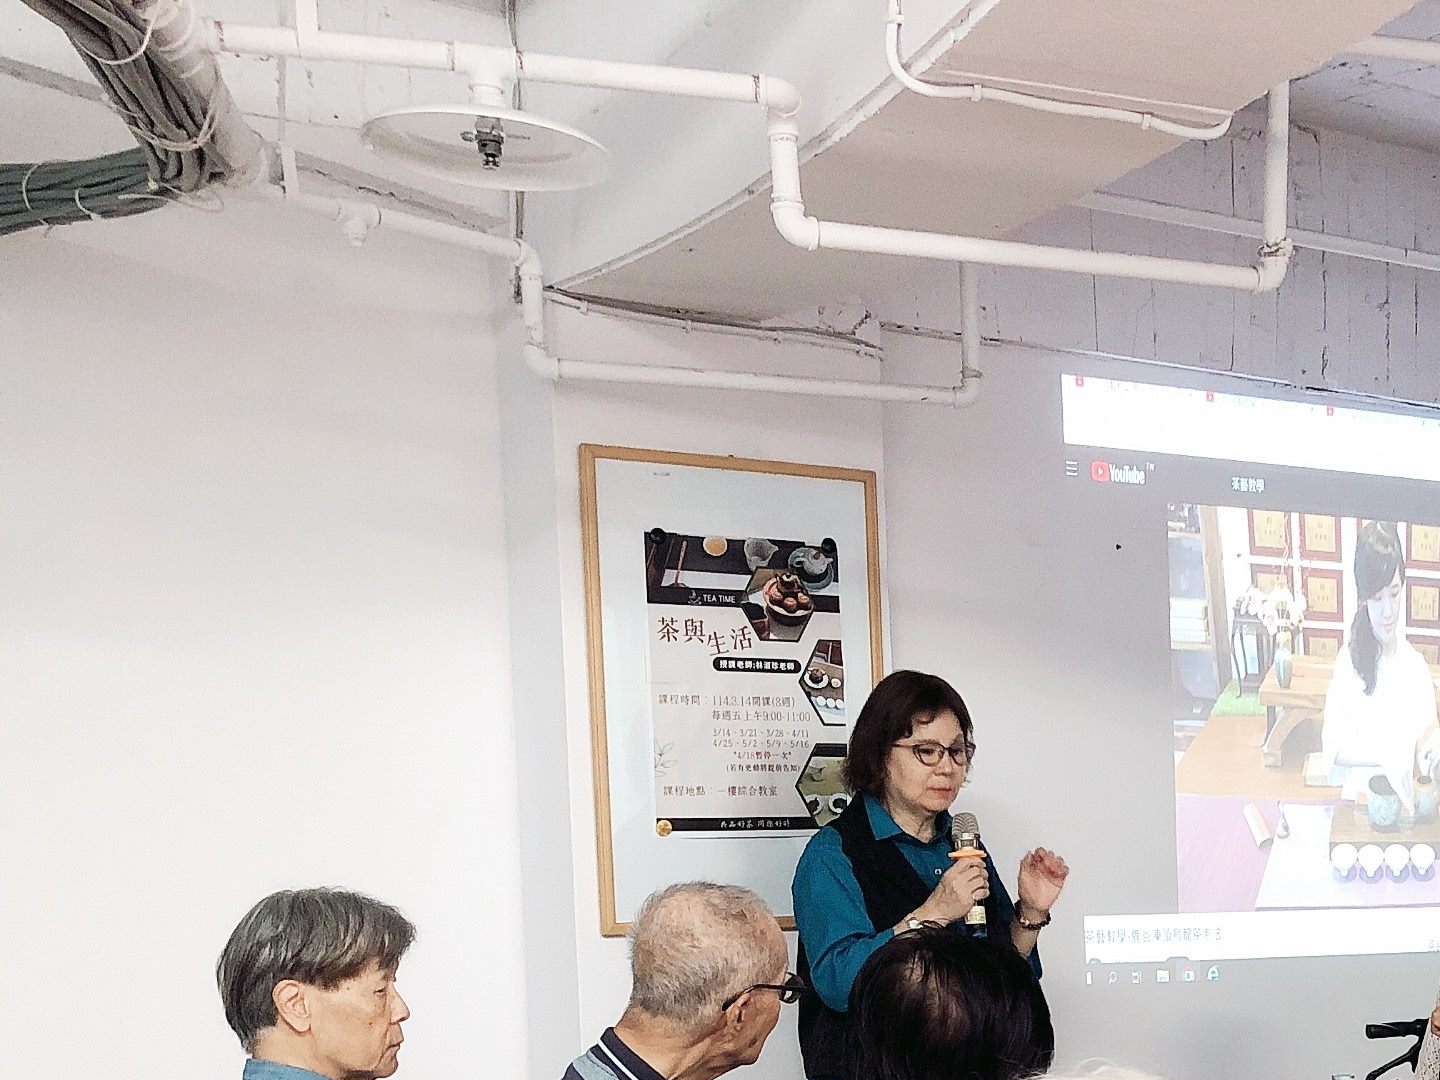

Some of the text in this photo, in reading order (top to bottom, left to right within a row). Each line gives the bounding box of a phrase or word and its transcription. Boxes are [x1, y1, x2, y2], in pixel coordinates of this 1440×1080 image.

[1109, 462, 1147, 485] YouTube
[1231, 476, 1265, 494] 茶藝教學
[702, 593, 736, 604] TEA TIME
[657, 616, 752, 657] 茶與生活
